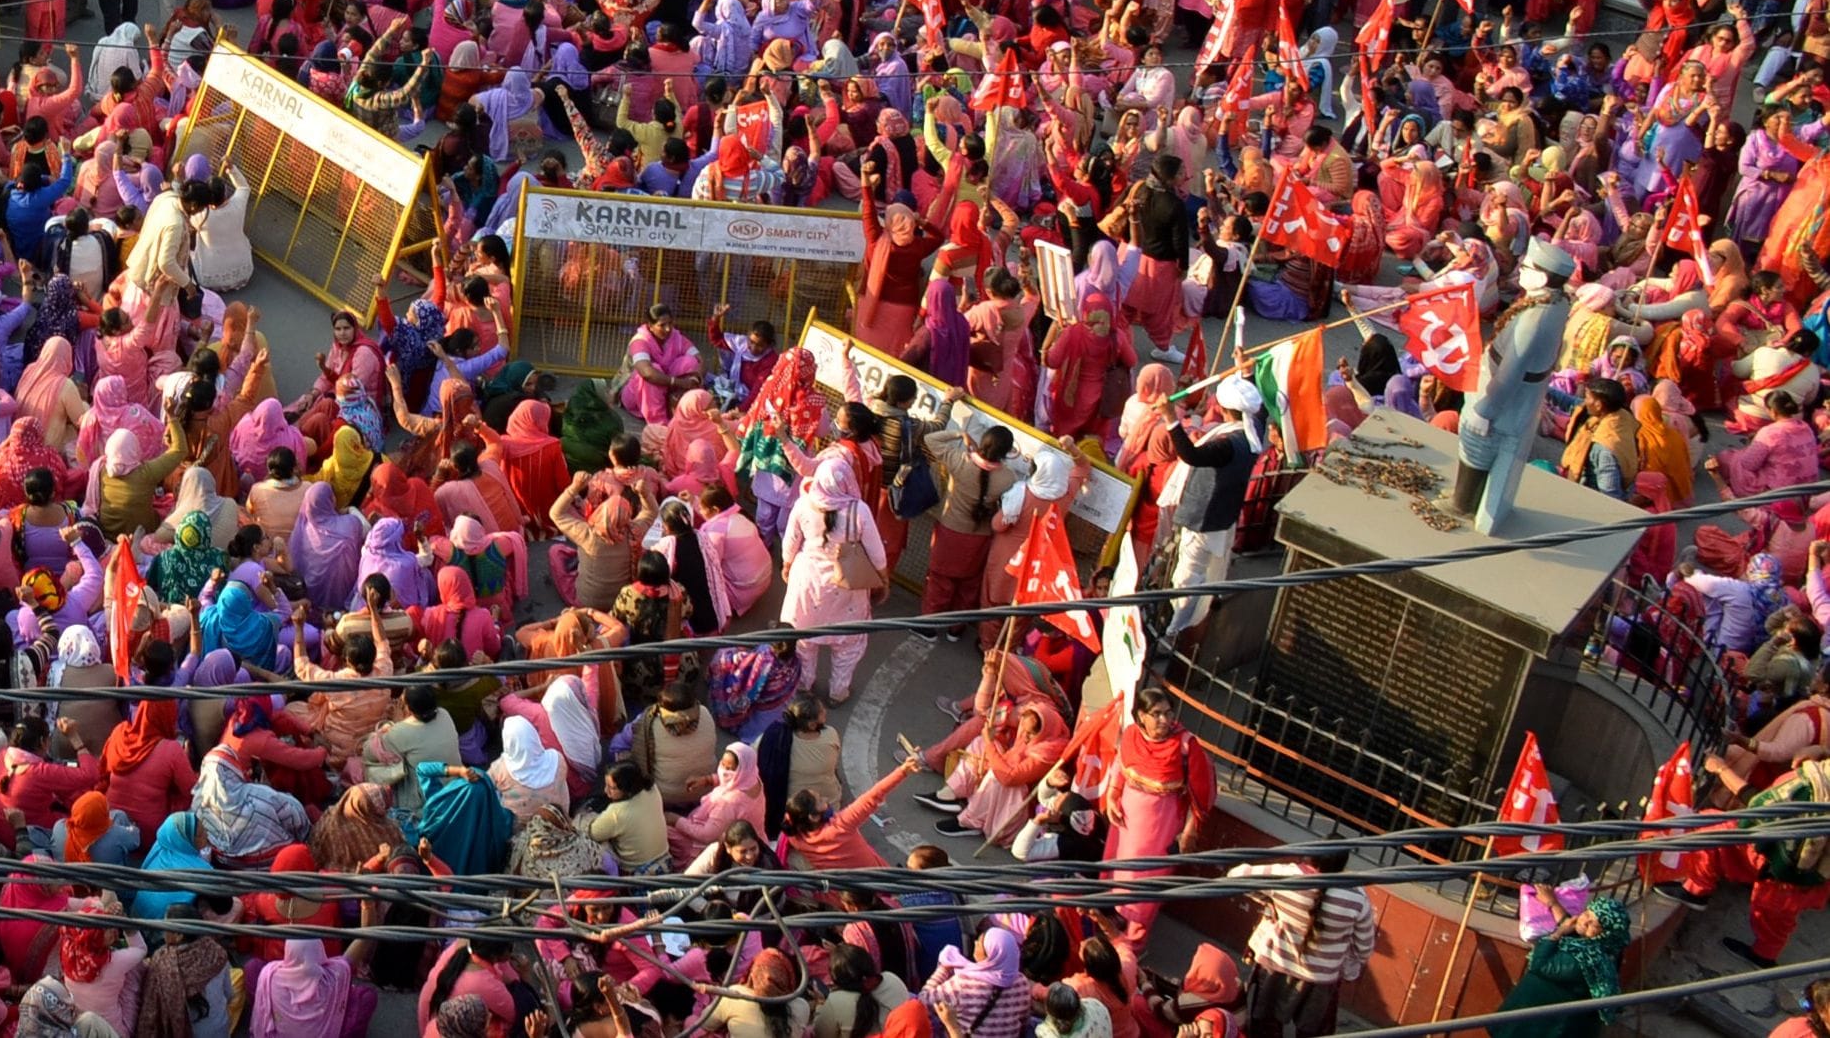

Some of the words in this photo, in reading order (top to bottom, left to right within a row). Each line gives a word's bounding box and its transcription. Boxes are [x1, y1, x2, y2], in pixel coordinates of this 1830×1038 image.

[240, 68, 305, 120] KARNAL
[575, 201, 688, 231] KARNAL
[584, 223, 643, 241] SMART
[648, 228, 677, 244] city
[730, 224, 760, 236] MSP
[765, 227, 804, 240] SMART
[806, 231, 831, 242] CITY
